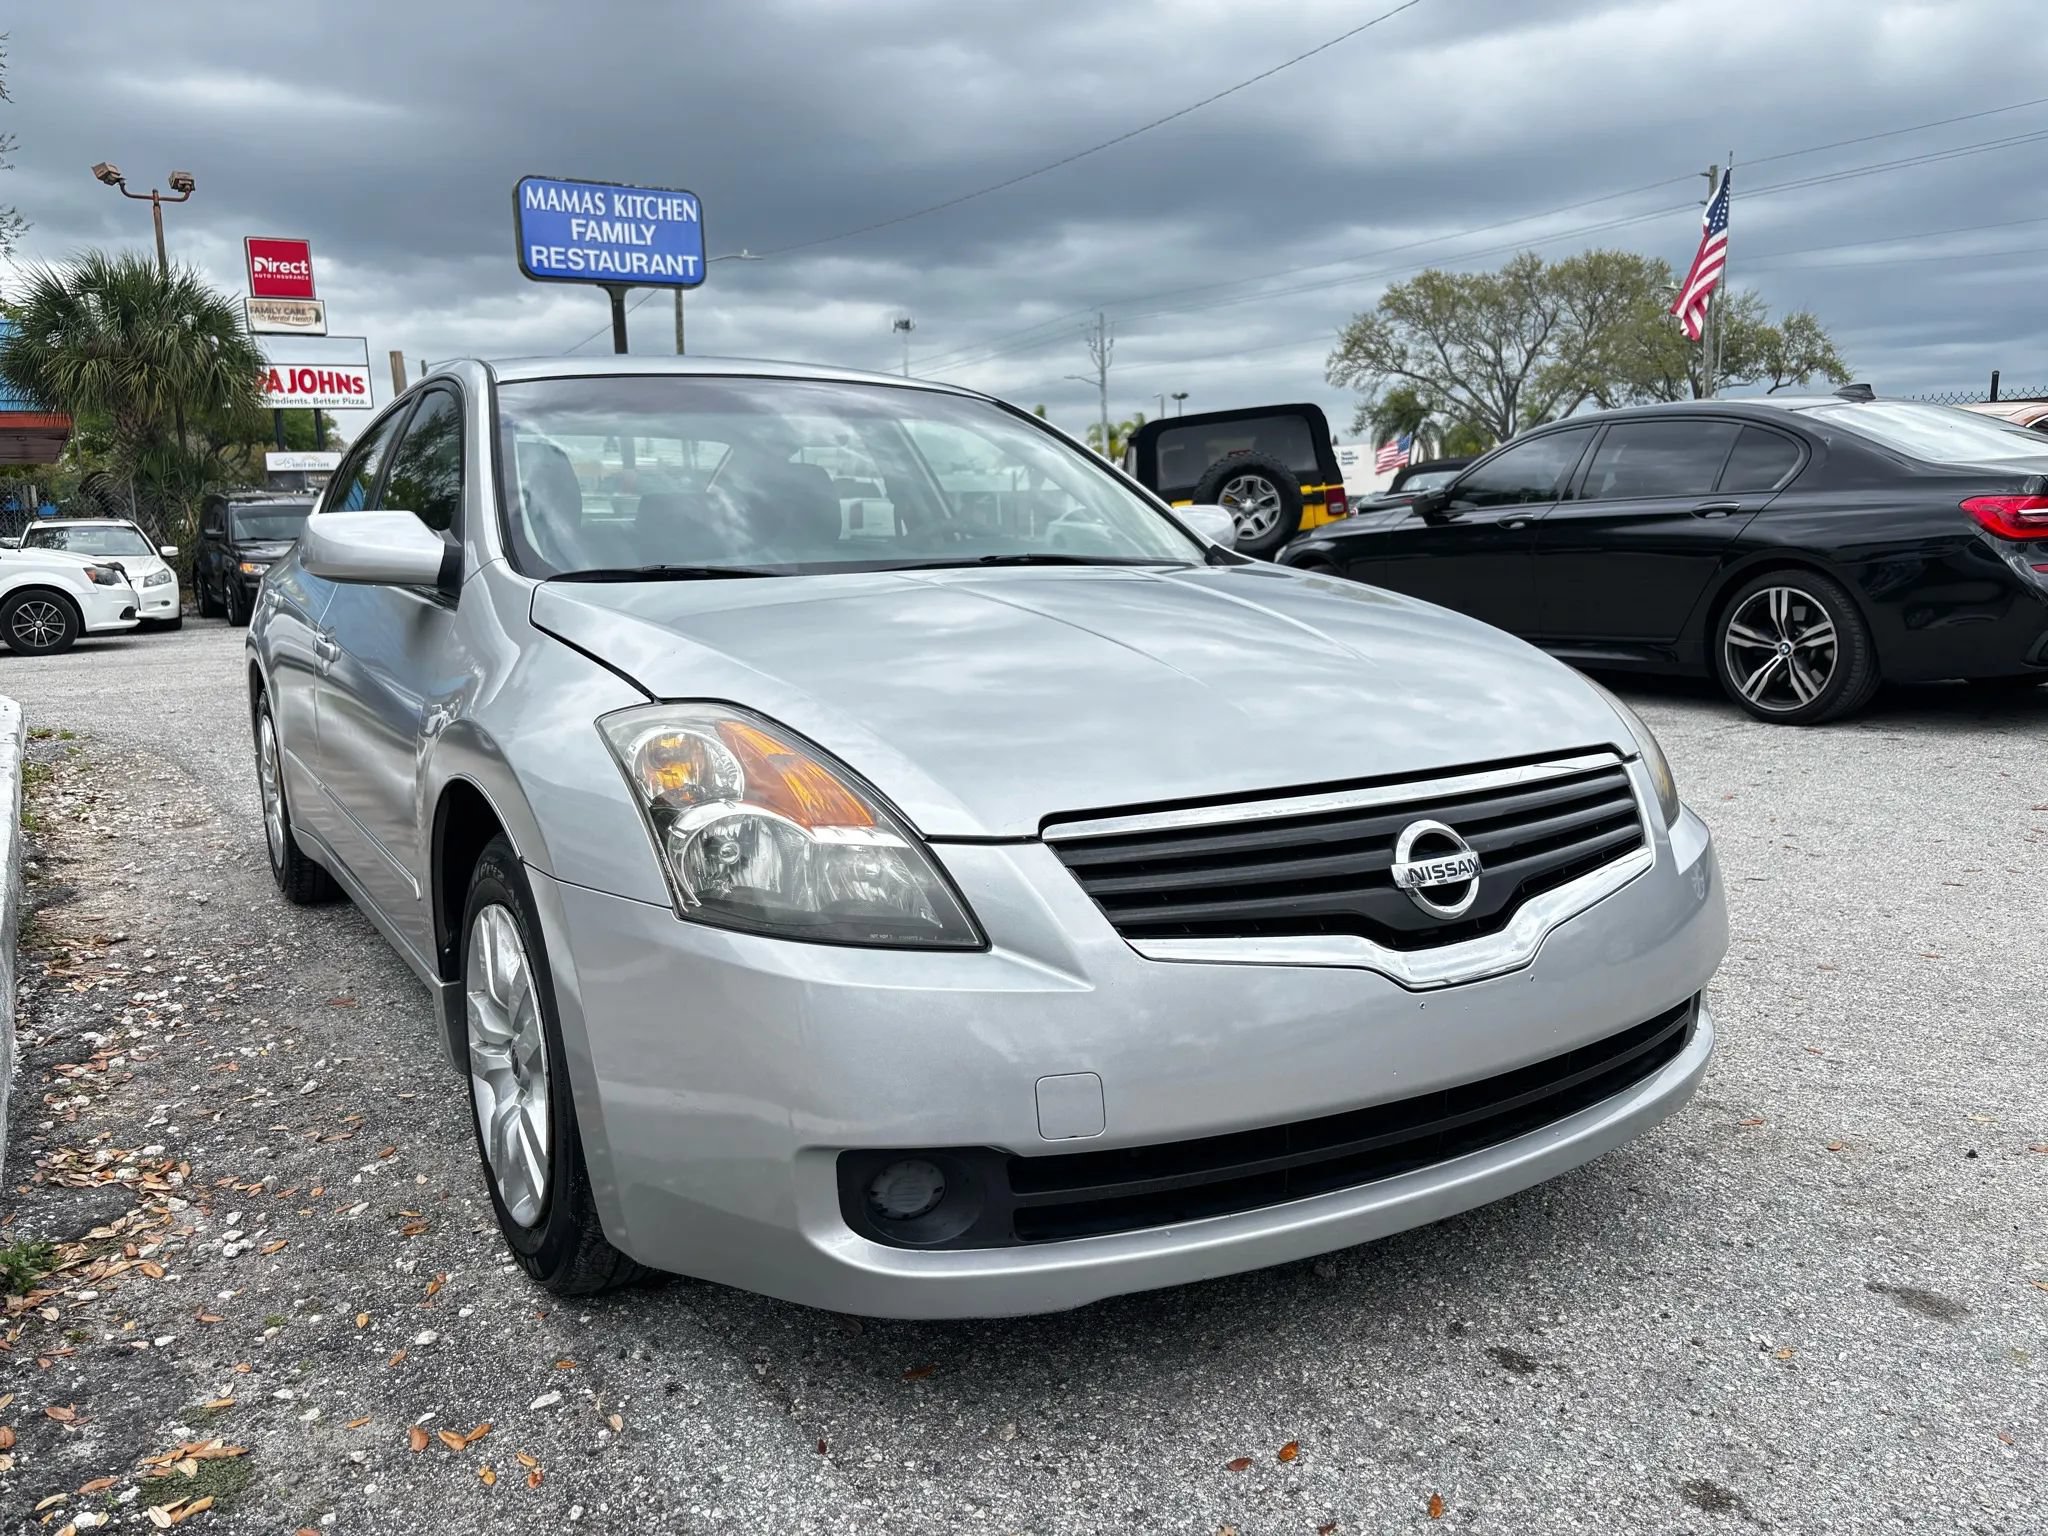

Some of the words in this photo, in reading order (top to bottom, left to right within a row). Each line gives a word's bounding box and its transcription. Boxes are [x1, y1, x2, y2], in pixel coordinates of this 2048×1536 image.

[525, 185, 606, 216] MAMAS
[613, 194, 697, 222] KITCHEN
[571, 218, 656, 246] FAMILY
[254, 256, 309, 275] Direct
[531, 245, 699, 277] RESTAURANT
[273, 273, 309, 281] INSURANCE
[249, 306, 281, 314] FAMILY
[283, 307, 306, 315] CARE
[287, 368, 365, 395] JOHNS
[313, 397, 340, 405] Better
[342, 397, 367, 405] Pizza.
[1407, 856, 1482, 882] NISSAN
